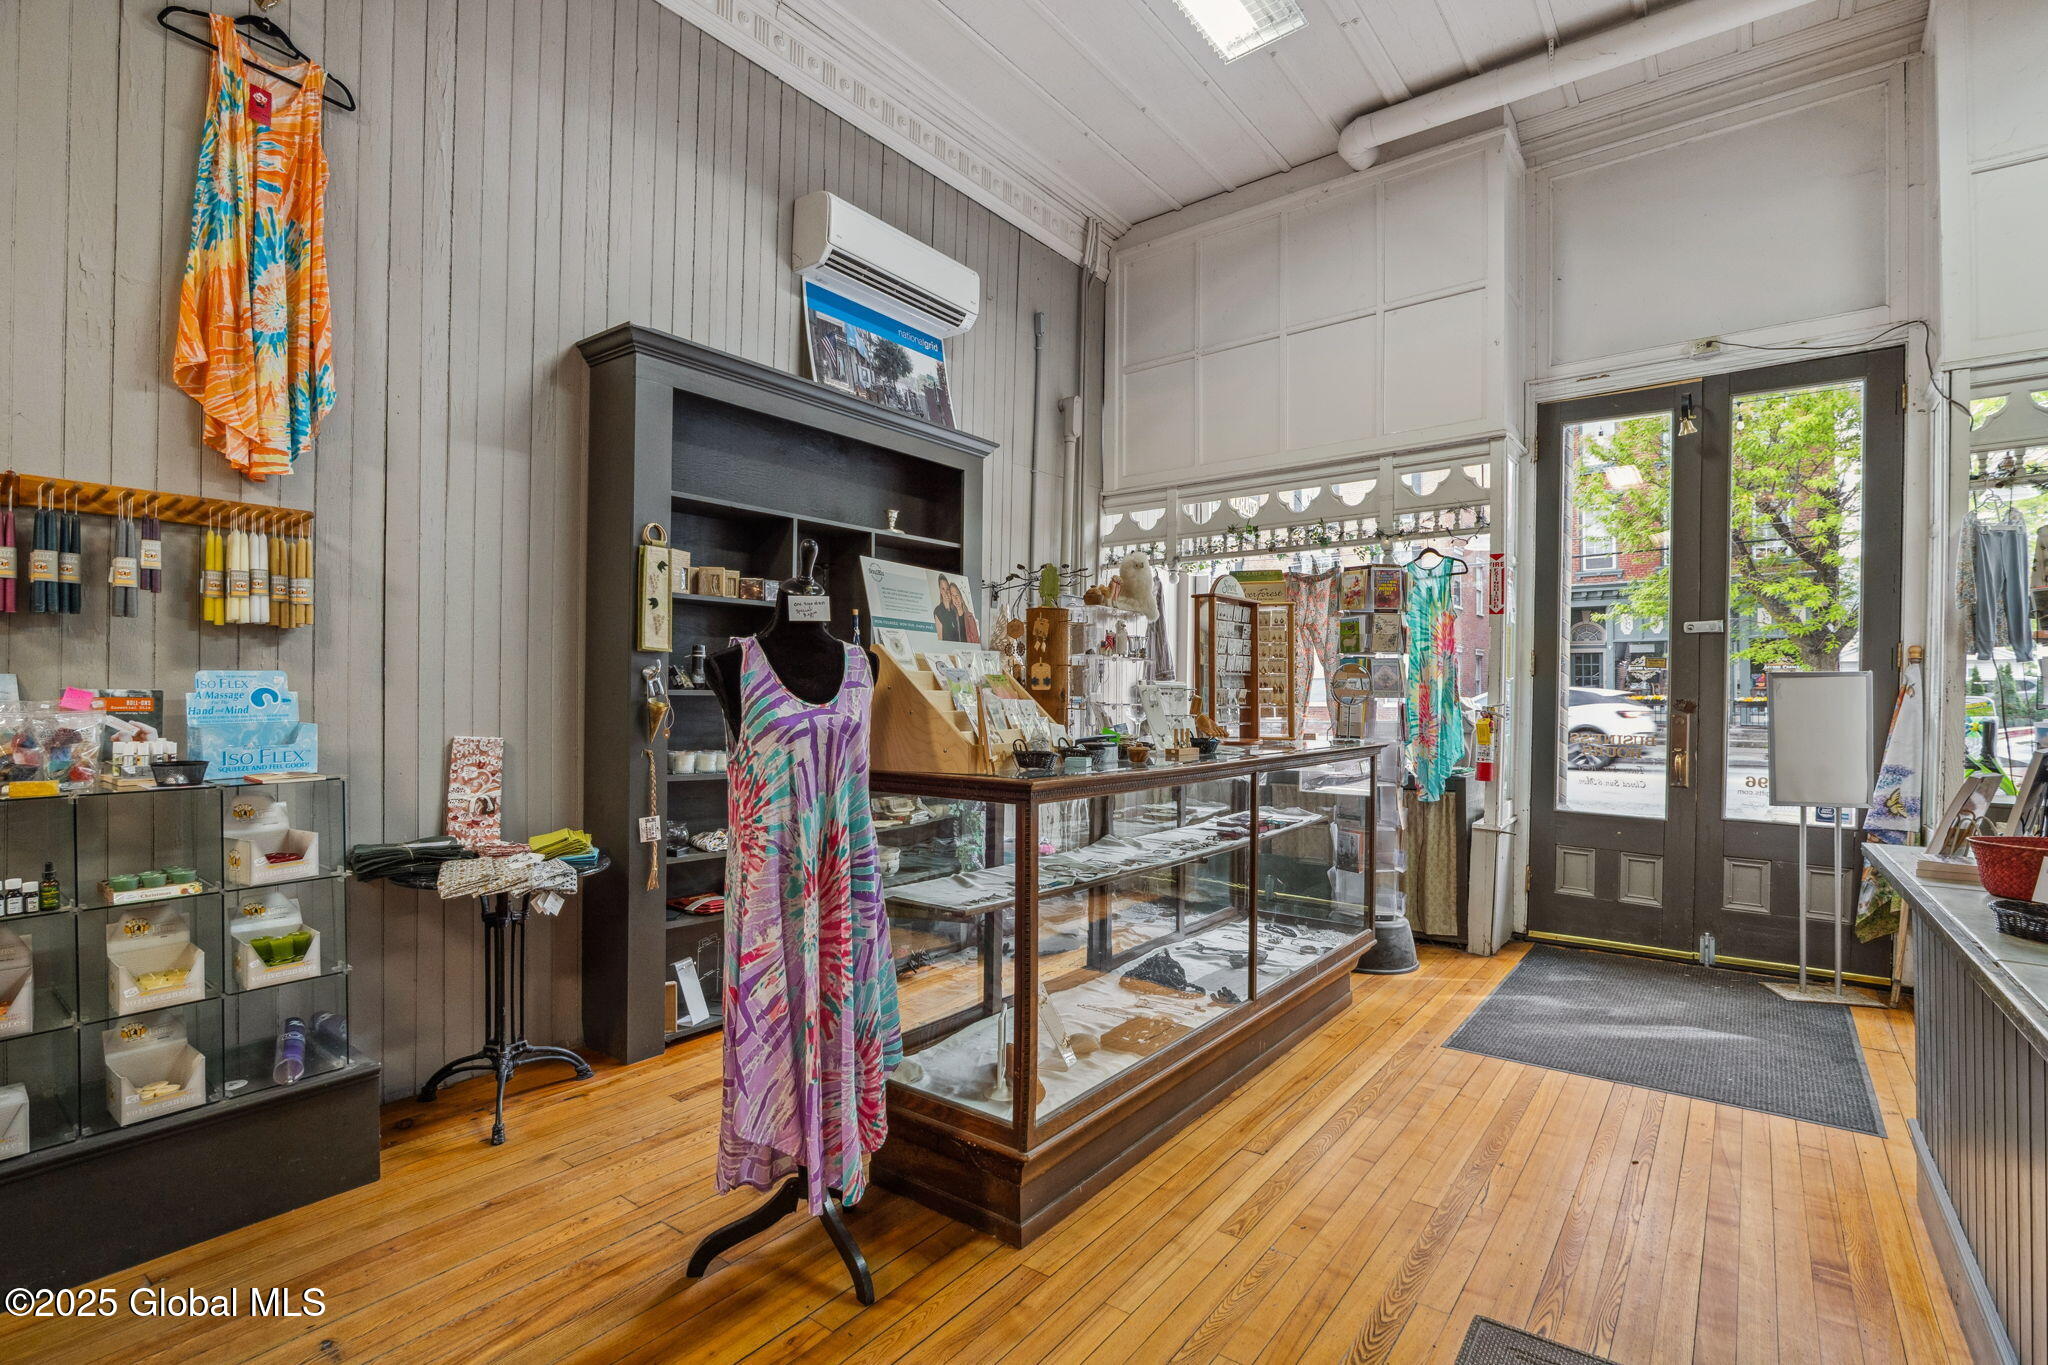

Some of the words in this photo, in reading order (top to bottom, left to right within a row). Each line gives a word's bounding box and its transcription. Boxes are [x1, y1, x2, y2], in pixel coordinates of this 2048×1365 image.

[898, 330, 939, 352] nationalgrid
[219, 678, 249, 689] FLEX
[204, 691, 245, 701] Massage
[188, 706, 214, 716] Hand
[224, 704, 250, 715] Mind
[259, 749, 305, 764] FLEX
[217, 765, 250, 773] SQUEEZE
